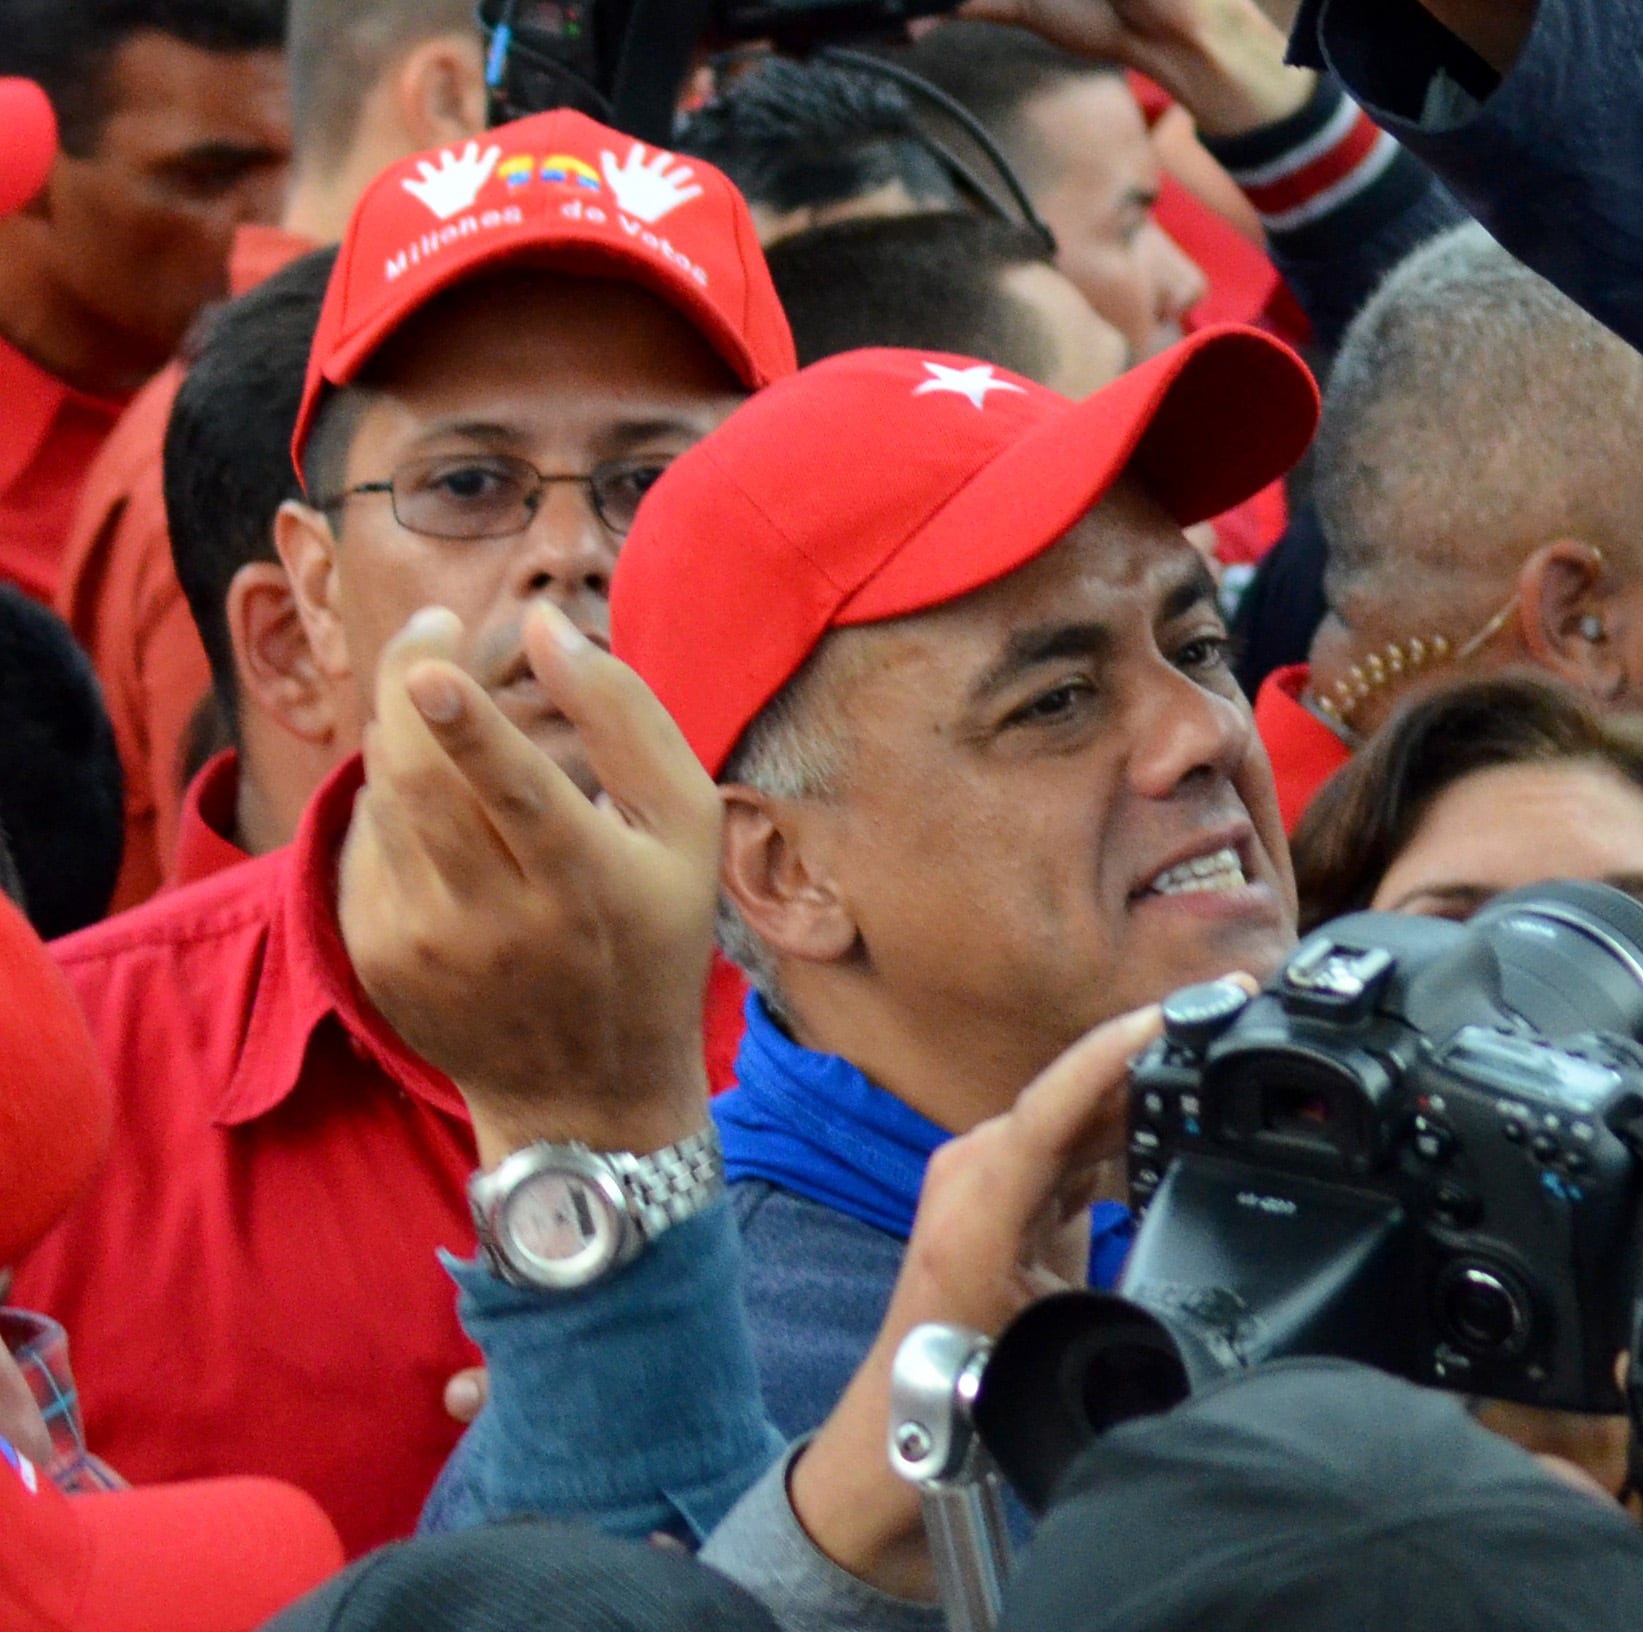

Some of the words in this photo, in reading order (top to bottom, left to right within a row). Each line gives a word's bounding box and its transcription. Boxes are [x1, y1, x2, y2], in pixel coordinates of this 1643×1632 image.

[385, 205, 522, 280] Millones
[560, 200, 606, 224] de
[618, 213, 708, 287] Votos
